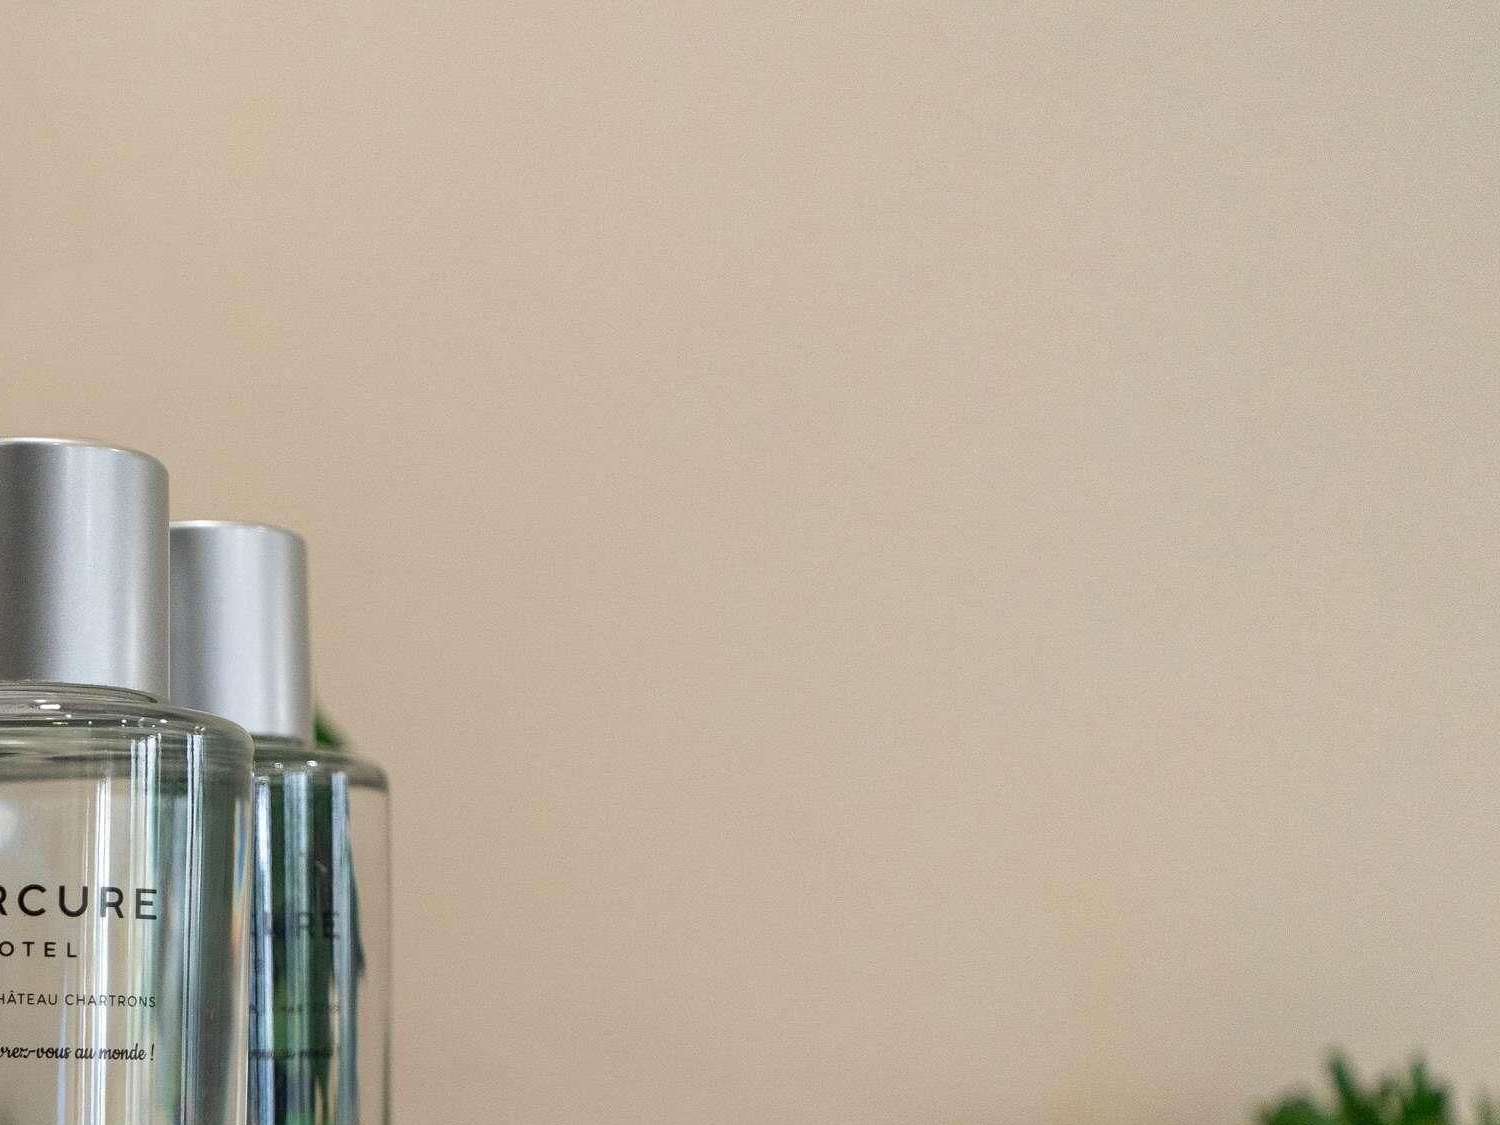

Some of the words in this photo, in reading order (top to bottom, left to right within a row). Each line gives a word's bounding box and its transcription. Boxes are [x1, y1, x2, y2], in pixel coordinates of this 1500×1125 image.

[64, 993, 157, 1009] CHARTRONS
[74, 1046, 95, 1060] au
[98, 1043, 146, 1061] monde
